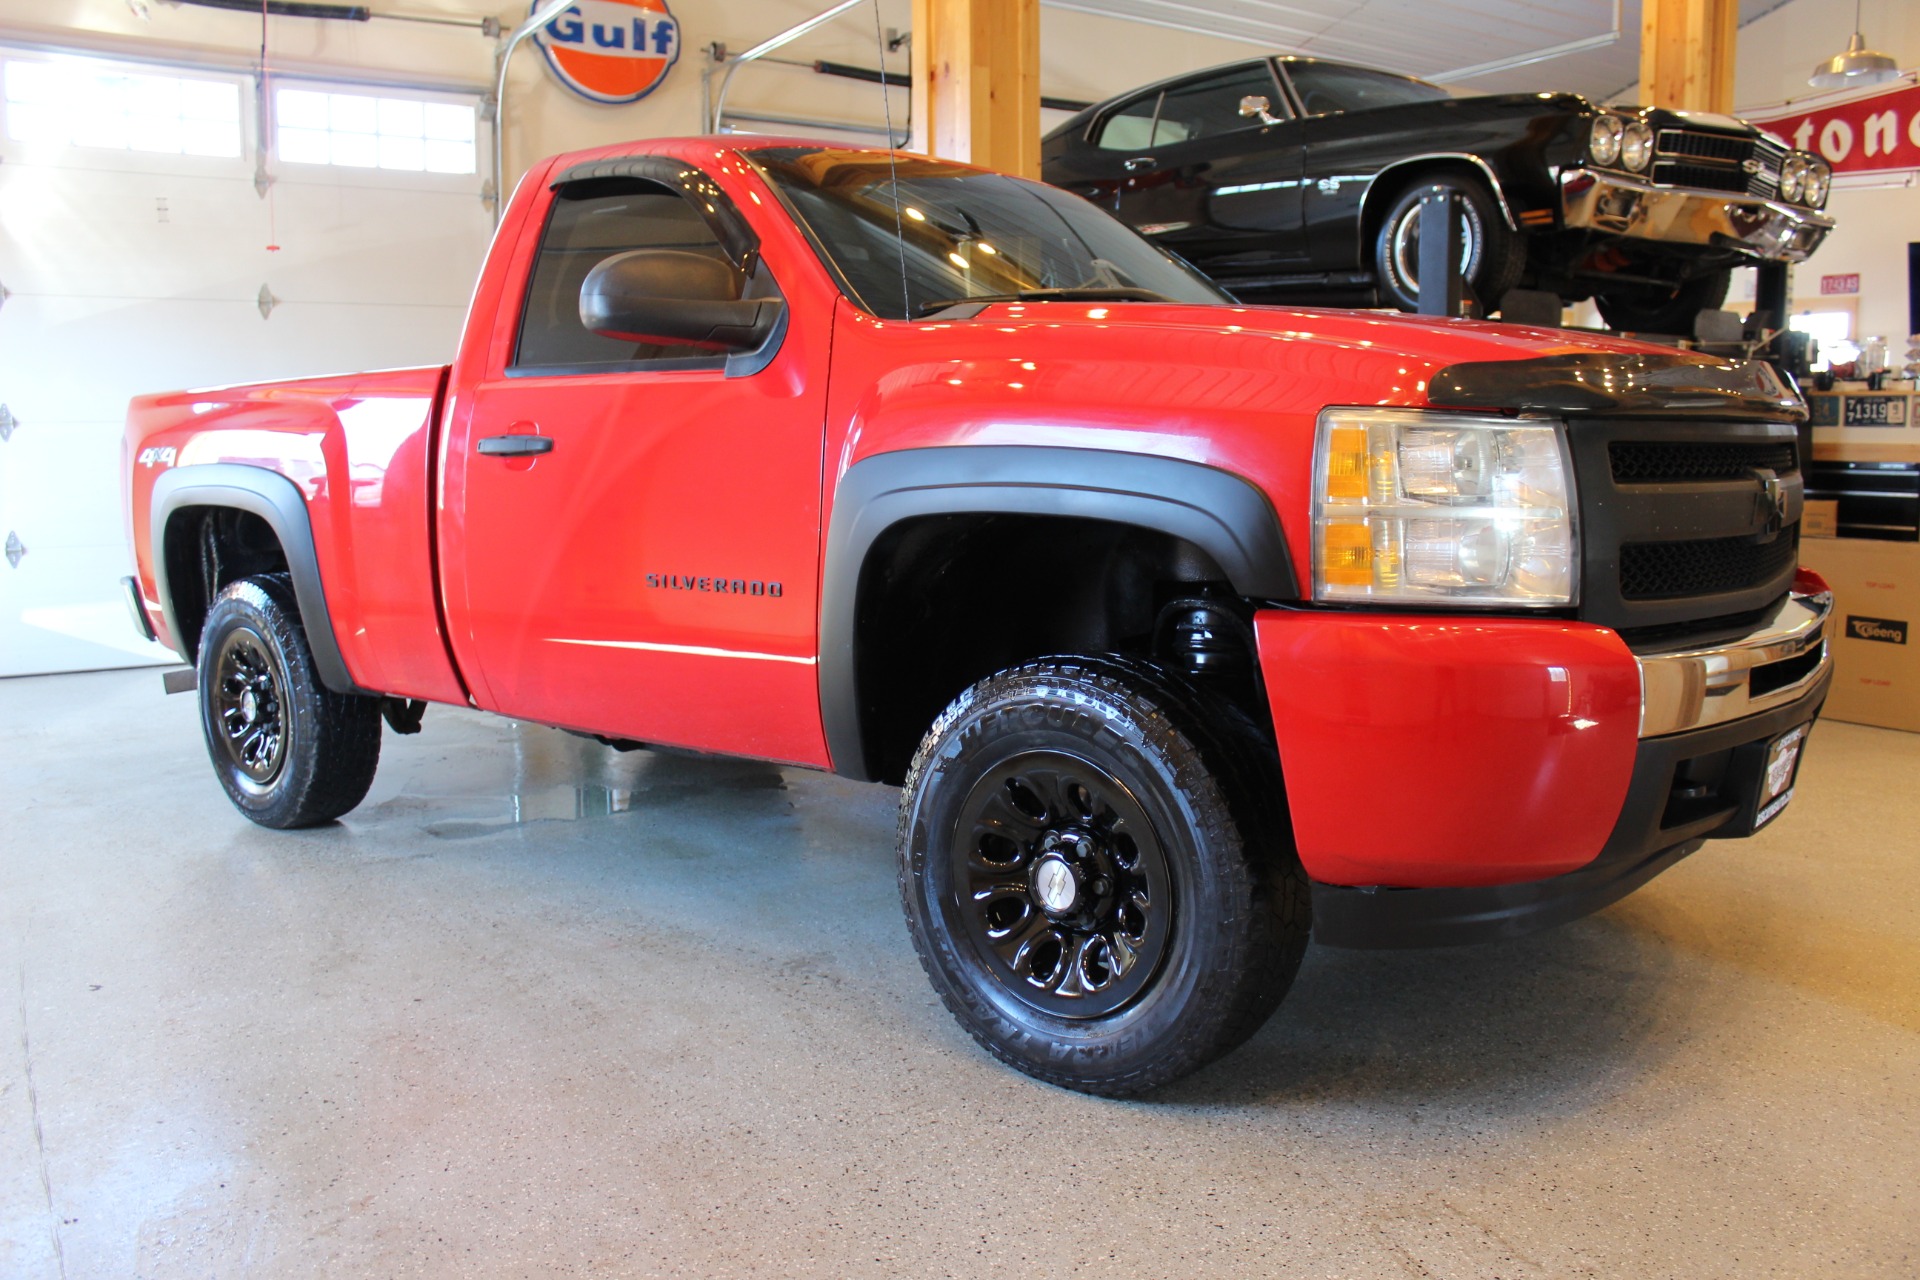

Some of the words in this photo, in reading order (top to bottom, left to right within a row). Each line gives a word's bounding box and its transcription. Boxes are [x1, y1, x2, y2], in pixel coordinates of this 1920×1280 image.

[546, 7, 674, 54] Gulf
[1856, 403, 1887, 419] 1319
[646, 573, 783, 597] SILVERADO
